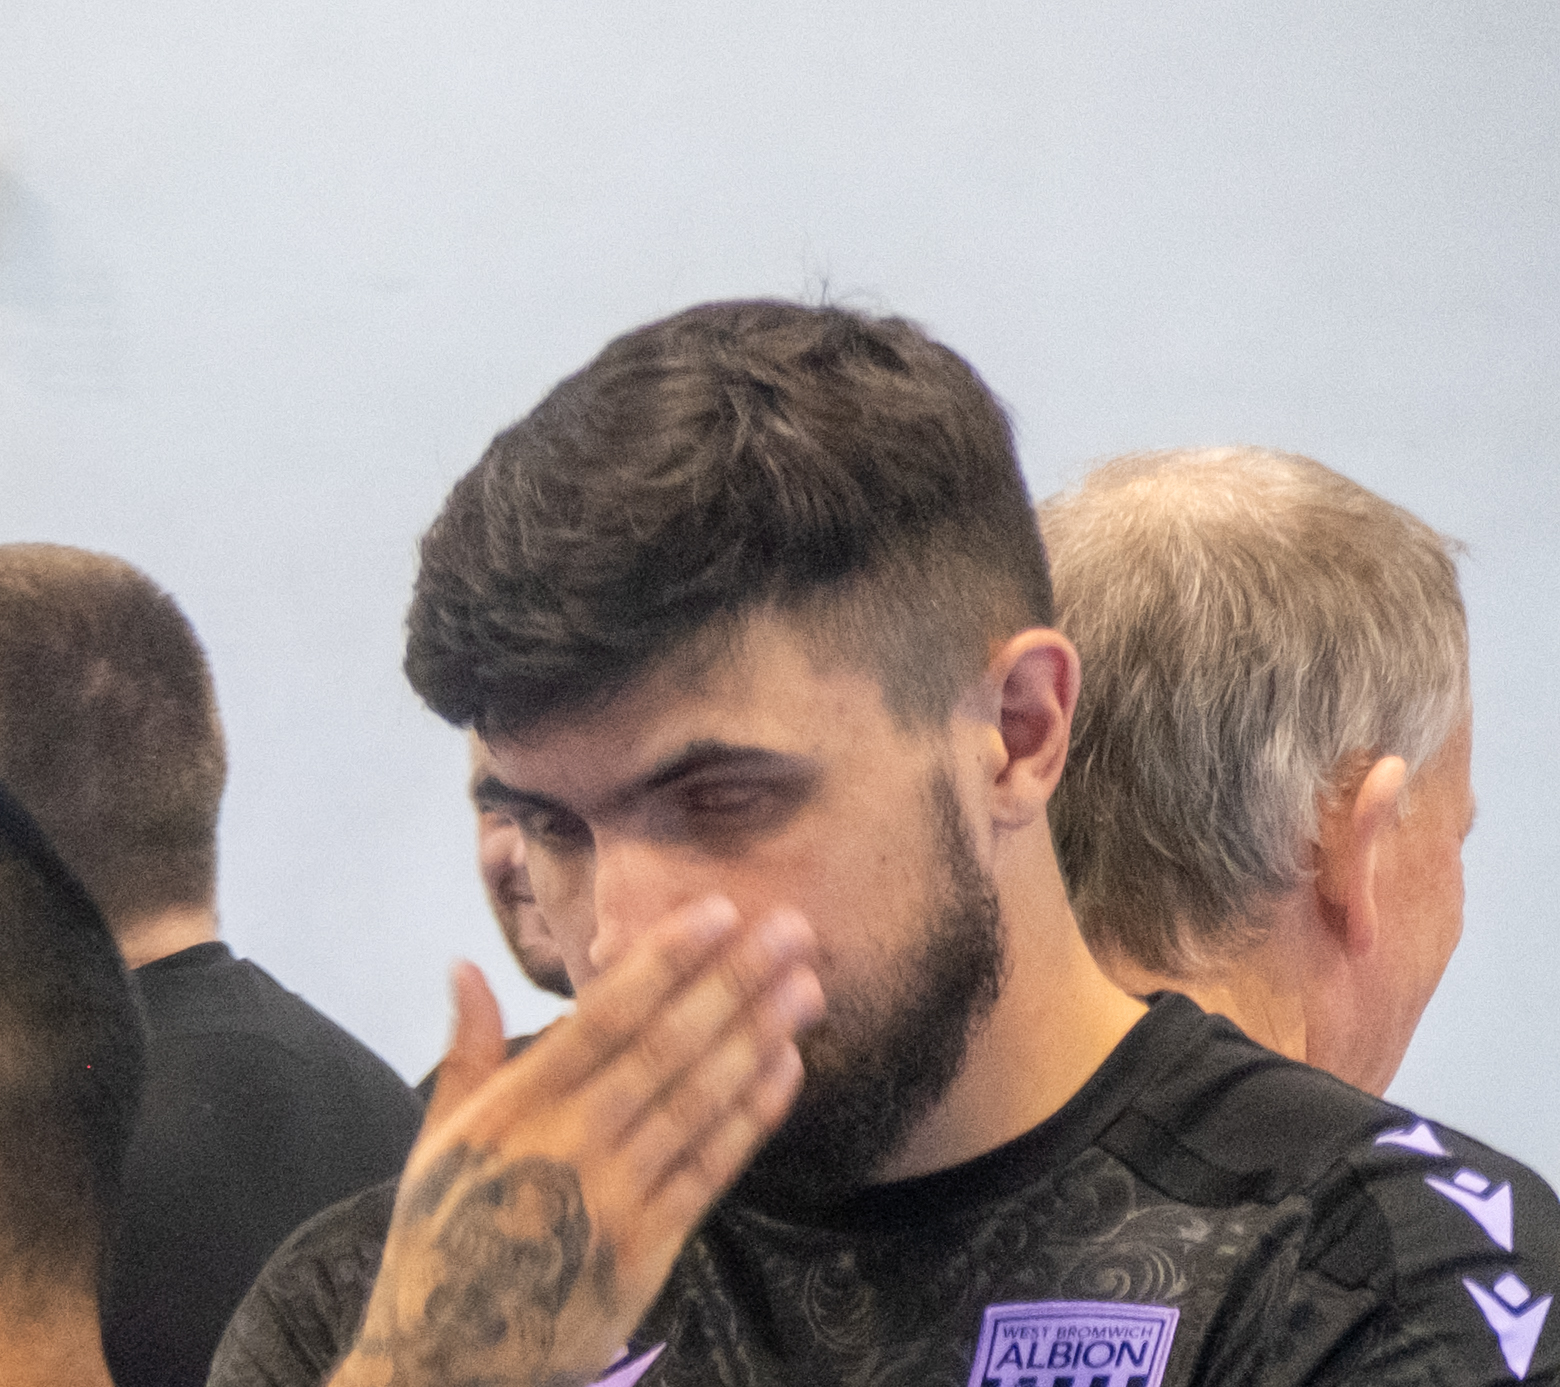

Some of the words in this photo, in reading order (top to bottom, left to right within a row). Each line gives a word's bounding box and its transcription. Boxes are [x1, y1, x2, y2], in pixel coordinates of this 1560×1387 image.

[1003, 1326, 1049, 1339] WEST
[1057, 1326, 1153, 1340] BROMWICH
[996, 1340, 1149, 1371] ALBION
